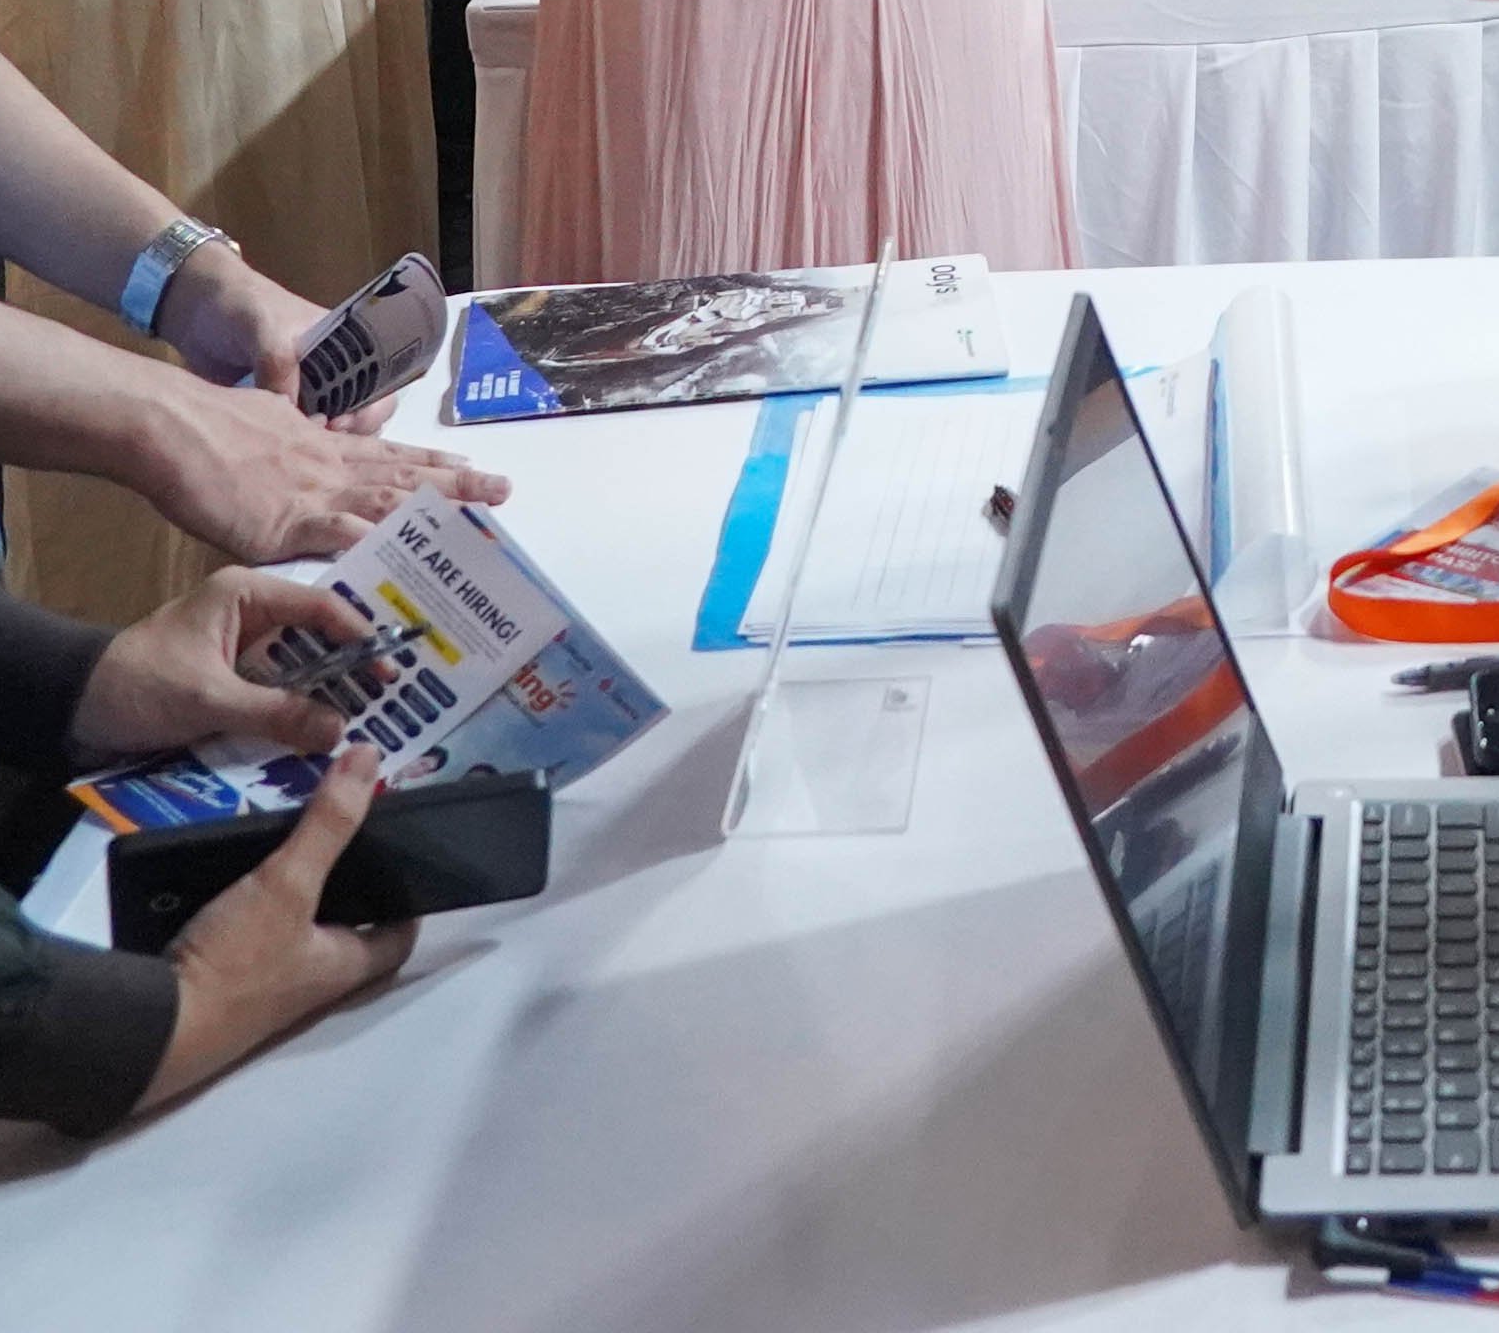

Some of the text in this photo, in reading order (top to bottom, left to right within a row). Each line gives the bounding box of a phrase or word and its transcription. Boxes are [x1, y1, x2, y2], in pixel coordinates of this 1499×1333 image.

[396, 519, 524, 646] WE ARE HIRING!
